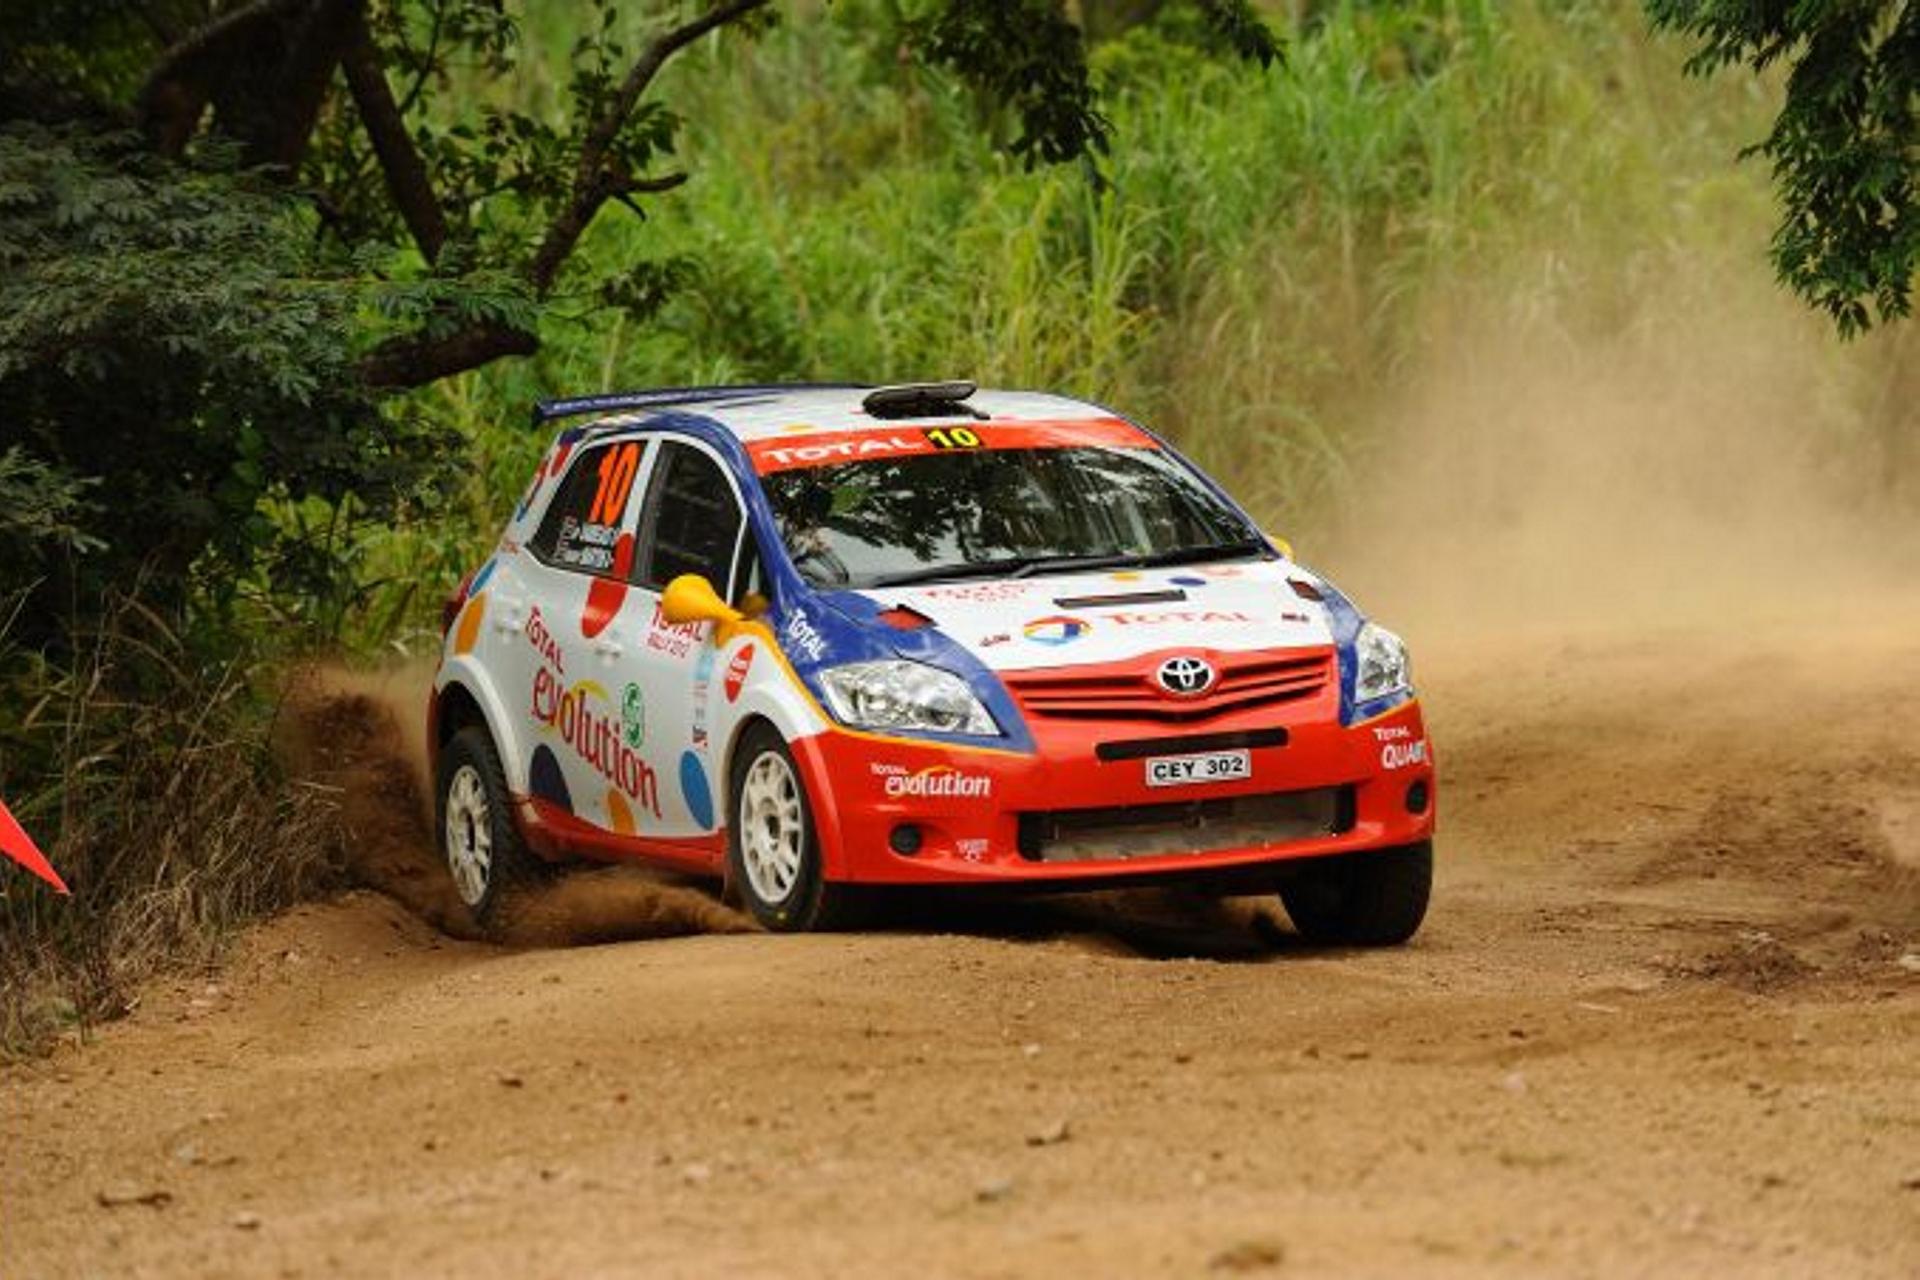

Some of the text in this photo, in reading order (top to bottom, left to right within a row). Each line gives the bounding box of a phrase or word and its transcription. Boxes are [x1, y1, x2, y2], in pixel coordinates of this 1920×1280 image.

[760, 427, 980, 464] TOTAL 10
[588, 441, 639, 528] 10
[1097, 610, 1262, 625] TOTAL
[524, 605, 565, 675] TOTAL
[786, 607, 825, 662] TOTAL
[530, 666, 663, 820] evolution
[1373, 726, 1411, 742] TOTAL
[869, 761, 910, 776] TOTAL
[884, 769, 992, 797] evolution
[1153, 756, 1244, 780] CEY 302
